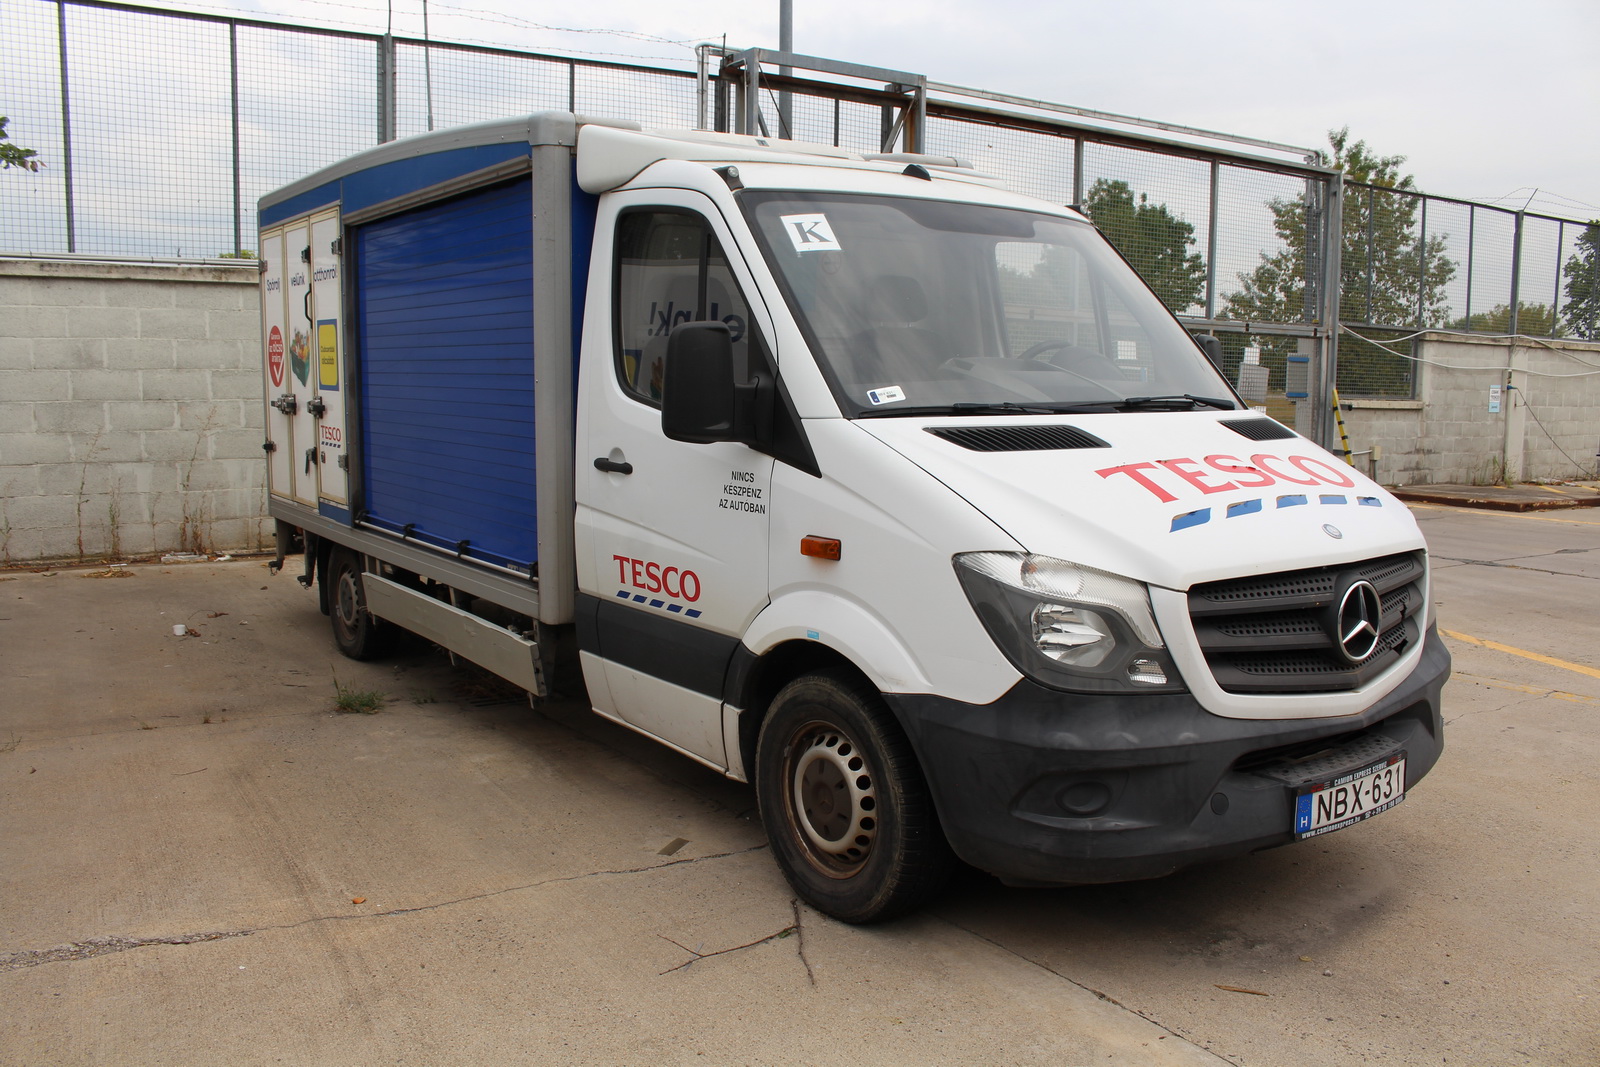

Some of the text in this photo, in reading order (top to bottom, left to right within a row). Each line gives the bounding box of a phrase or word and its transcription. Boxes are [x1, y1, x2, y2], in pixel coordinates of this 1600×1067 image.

[790, 221, 833, 243] K
[320, 425, 341, 442] TESCO
[731, 470, 755, 483] NINCS
[1094, 454, 1355, 503] TESCO
[723, 482, 762, 499] KÉSZPÉNZ
[719, 498, 766, 514] AZ AUTÓBAN
[613, 554, 701, 602] TESCO
[1334, 774, 1353, 786] CAMION
[1353, 767, 1372, 780] EXPRESS
[1316, 765, 1401, 825] NBX-631
[1300, 815, 1308, 828] H
